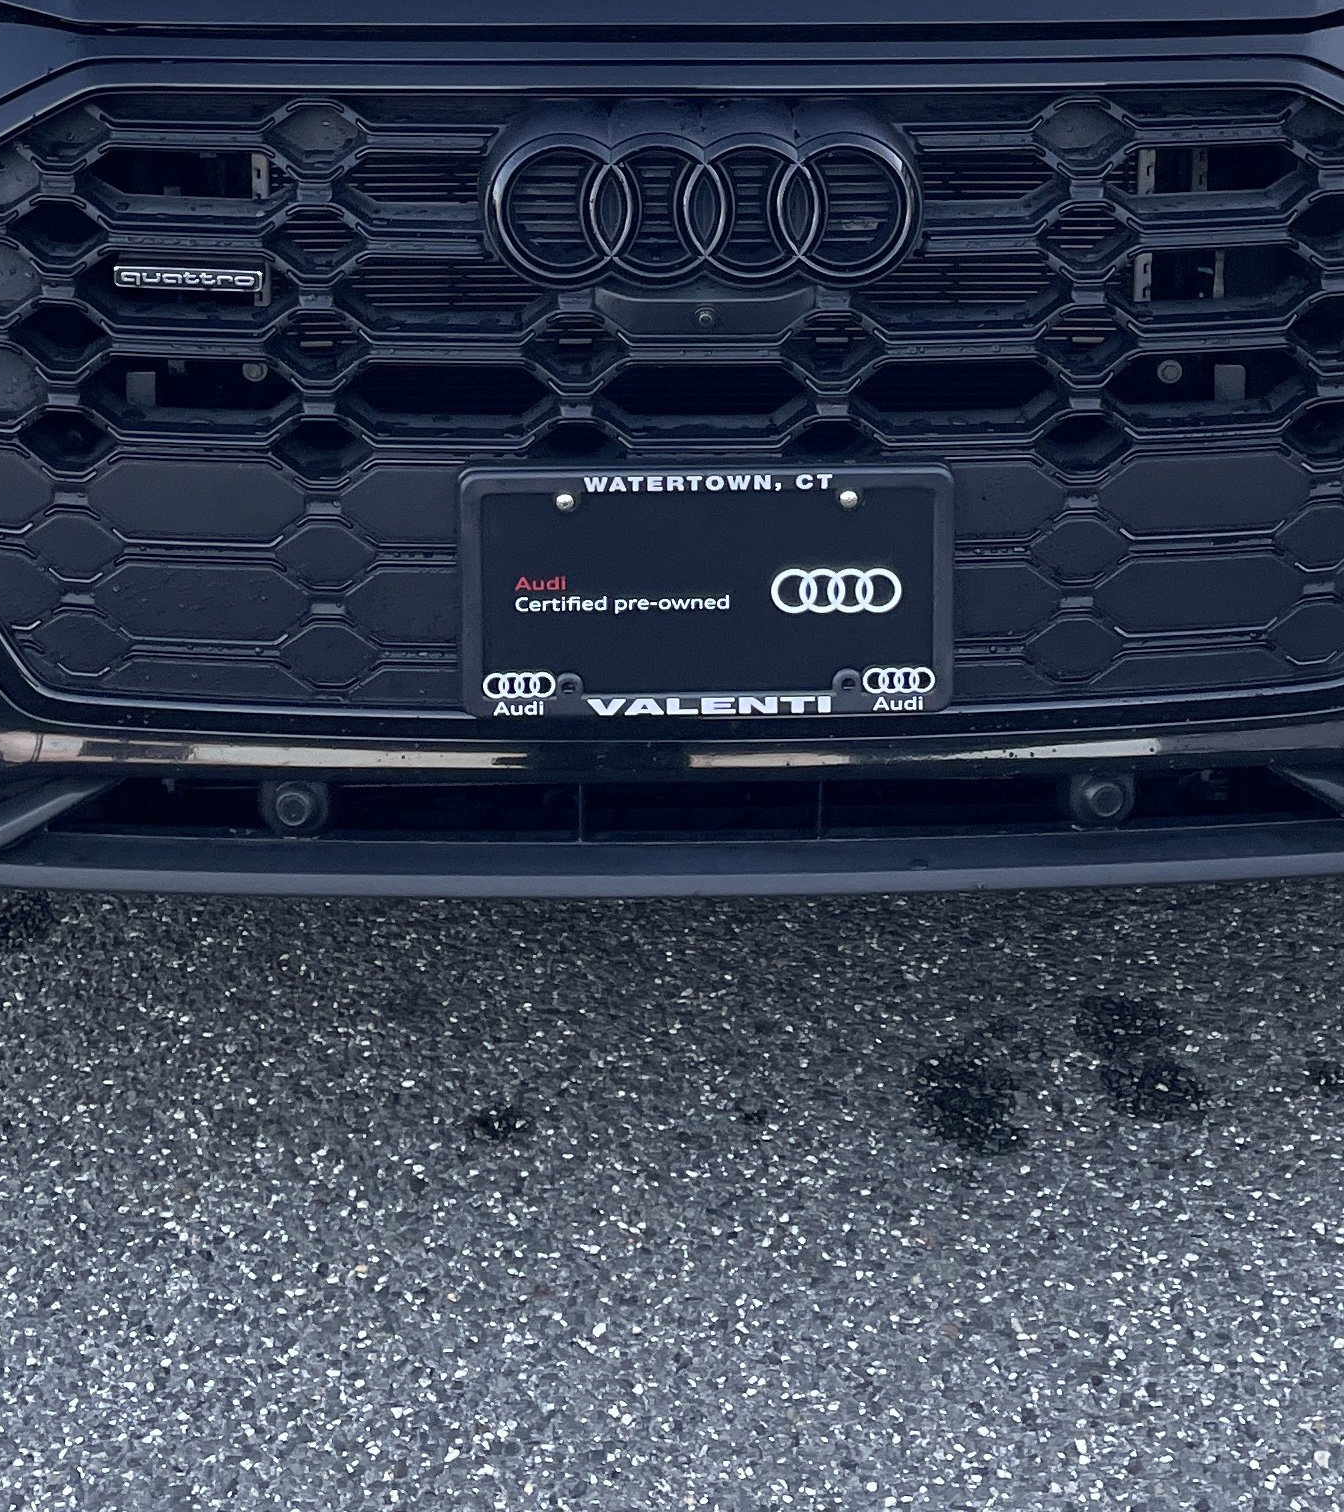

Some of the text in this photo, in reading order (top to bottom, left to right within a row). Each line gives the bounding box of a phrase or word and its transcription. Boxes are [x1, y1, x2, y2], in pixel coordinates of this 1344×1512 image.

[120, 271, 255, 286] quattro
[583, 473, 833, 492] WATERTOWN, CT
[514, 575, 567, 591] Audi
[514, 594, 731, 614] Certified pre-owned
[493, 700, 544, 716] Audi
[586, 694, 832, 716] VALENTI
[872, 695, 924, 711] Audi
